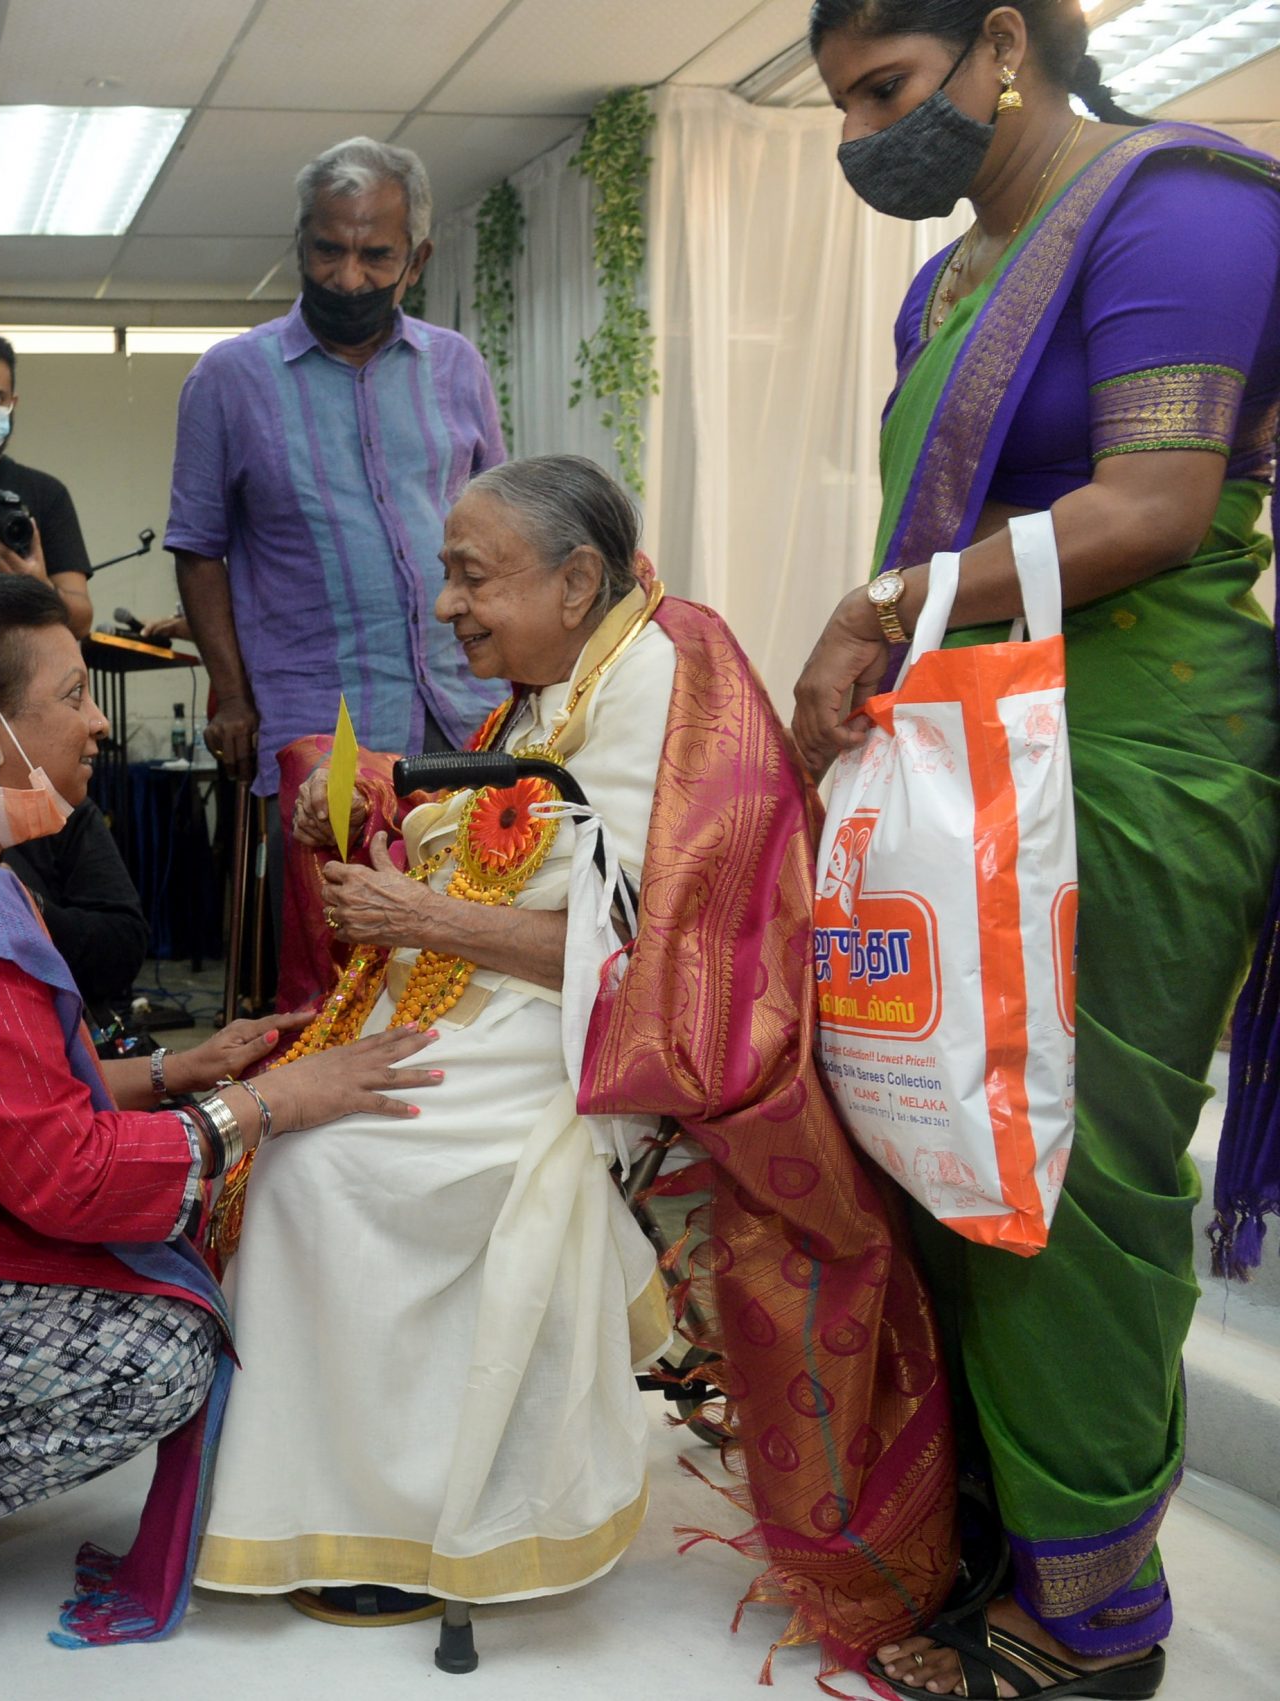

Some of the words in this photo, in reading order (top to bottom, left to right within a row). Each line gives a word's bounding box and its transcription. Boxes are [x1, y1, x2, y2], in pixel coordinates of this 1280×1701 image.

[876, 1052, 903, 1065] Lowest
[905, 1054, 936, 1068] Price!!!
[843, 1063, 856, 1077] Silk
[857, 1067, 885, 1083] Sarees
[887, 1071, 942, 1090] Collection
[853, 1087, 880, 1102] KLANG
[899, 1095, 948, 1112] MELAKA
[934, 1117, 950, 1127] 2617
